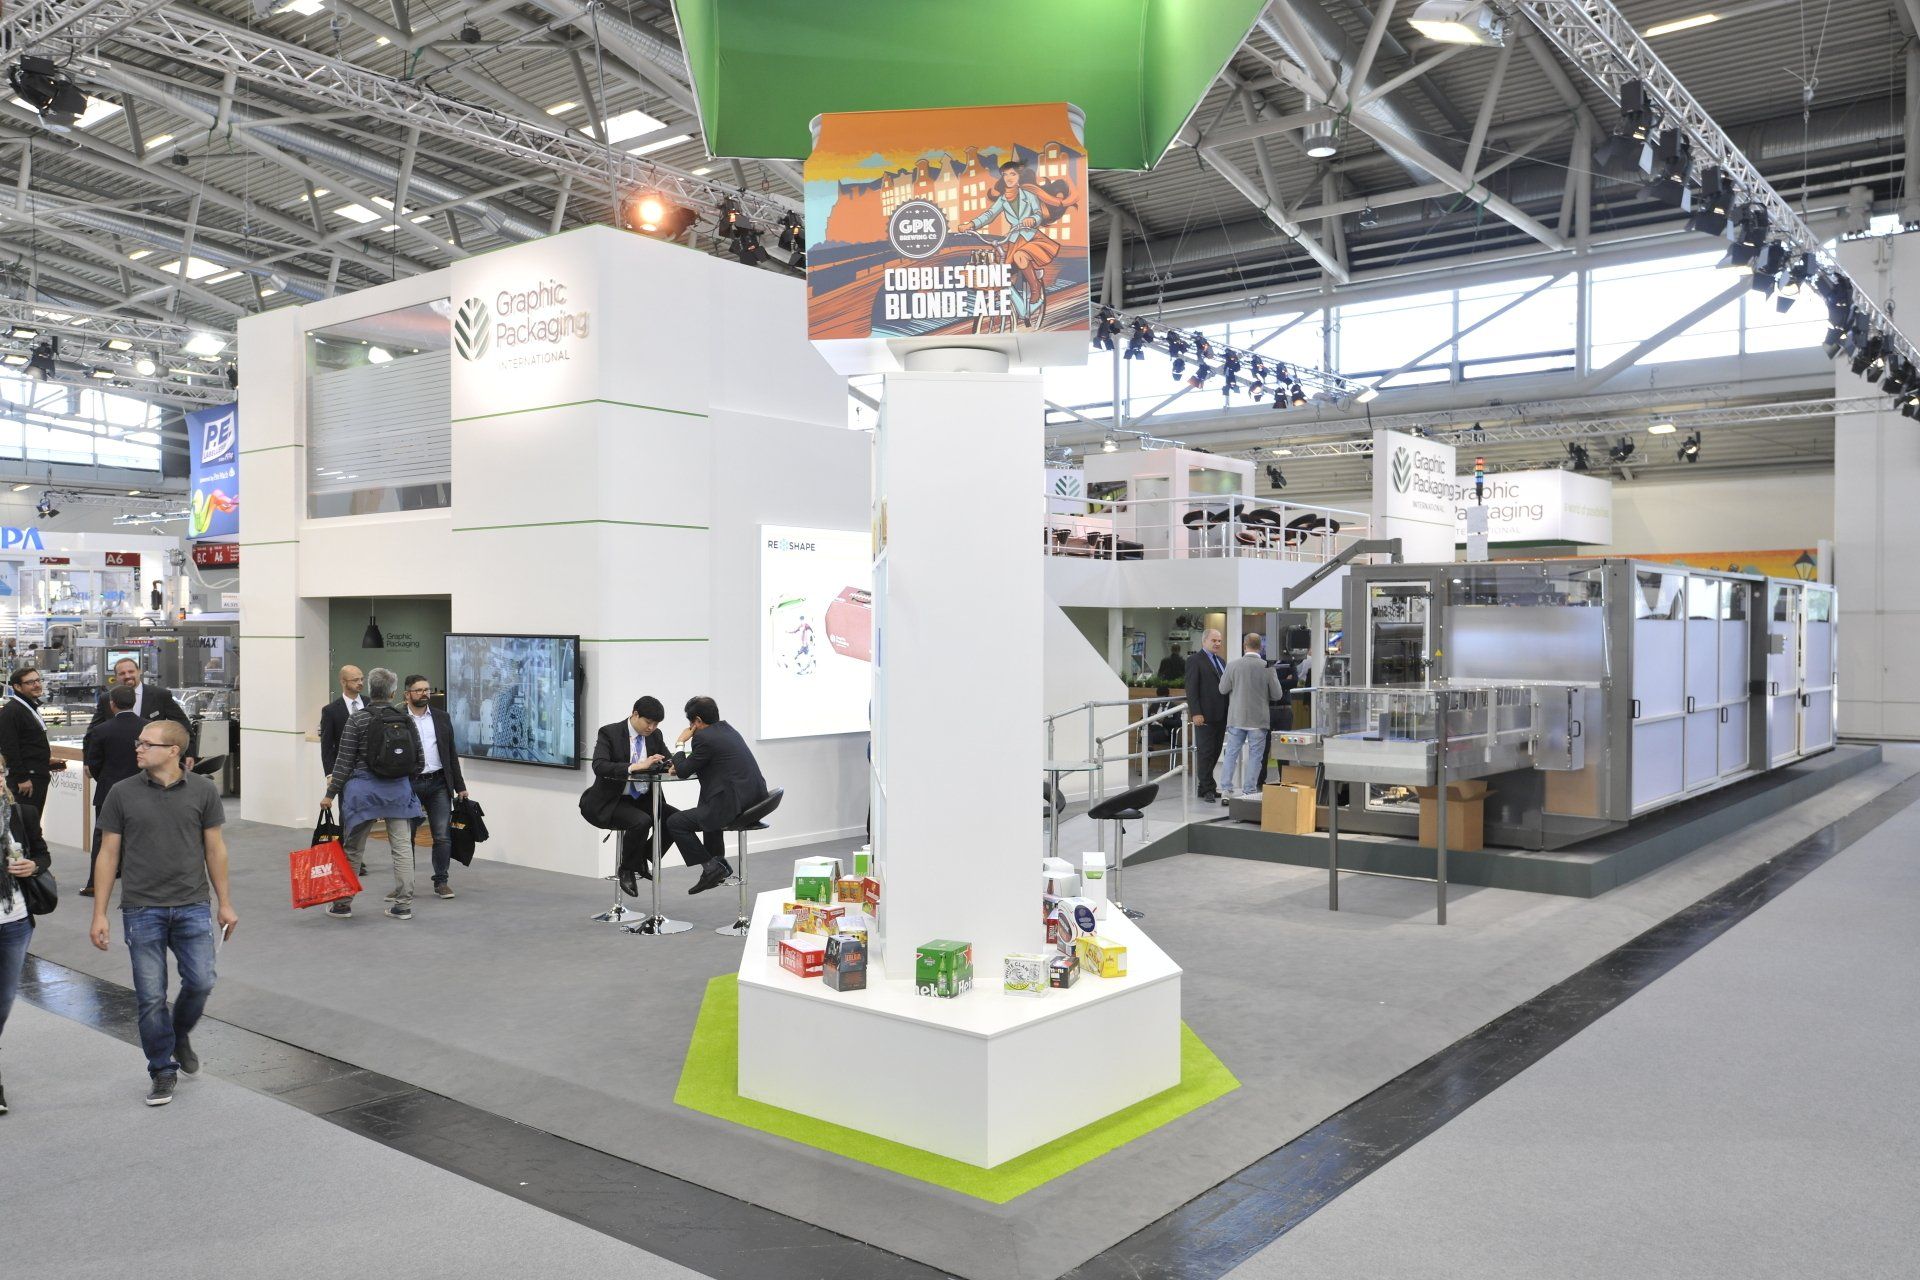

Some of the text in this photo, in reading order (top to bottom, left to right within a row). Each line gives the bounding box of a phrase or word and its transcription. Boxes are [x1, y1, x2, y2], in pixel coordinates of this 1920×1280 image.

[899, 218, 936, 234] GPK
[884, 263, 1012, 292] COBBLESTONE
[496, 278, 568, 317] Graphic
[885, 286, 1013, 320] BLONDE ALE
[496, 309, 590, 347] Packaging
[499, 350, 570, 370] INTERNATIONAL
[1414, 450, 1446, 475] Graphic
[1414, 473, 1455, 502] Packaging
[1455, 502, 1544, 521] aaging
[767, 540, 816, 551] RE SHAPE
[106, 554, 124, 565] A6
[386, 632, 413, 641] Graphic
[386, 640, 420, 649] Packaging
[1014, 961, 1030, 972] CLAW
